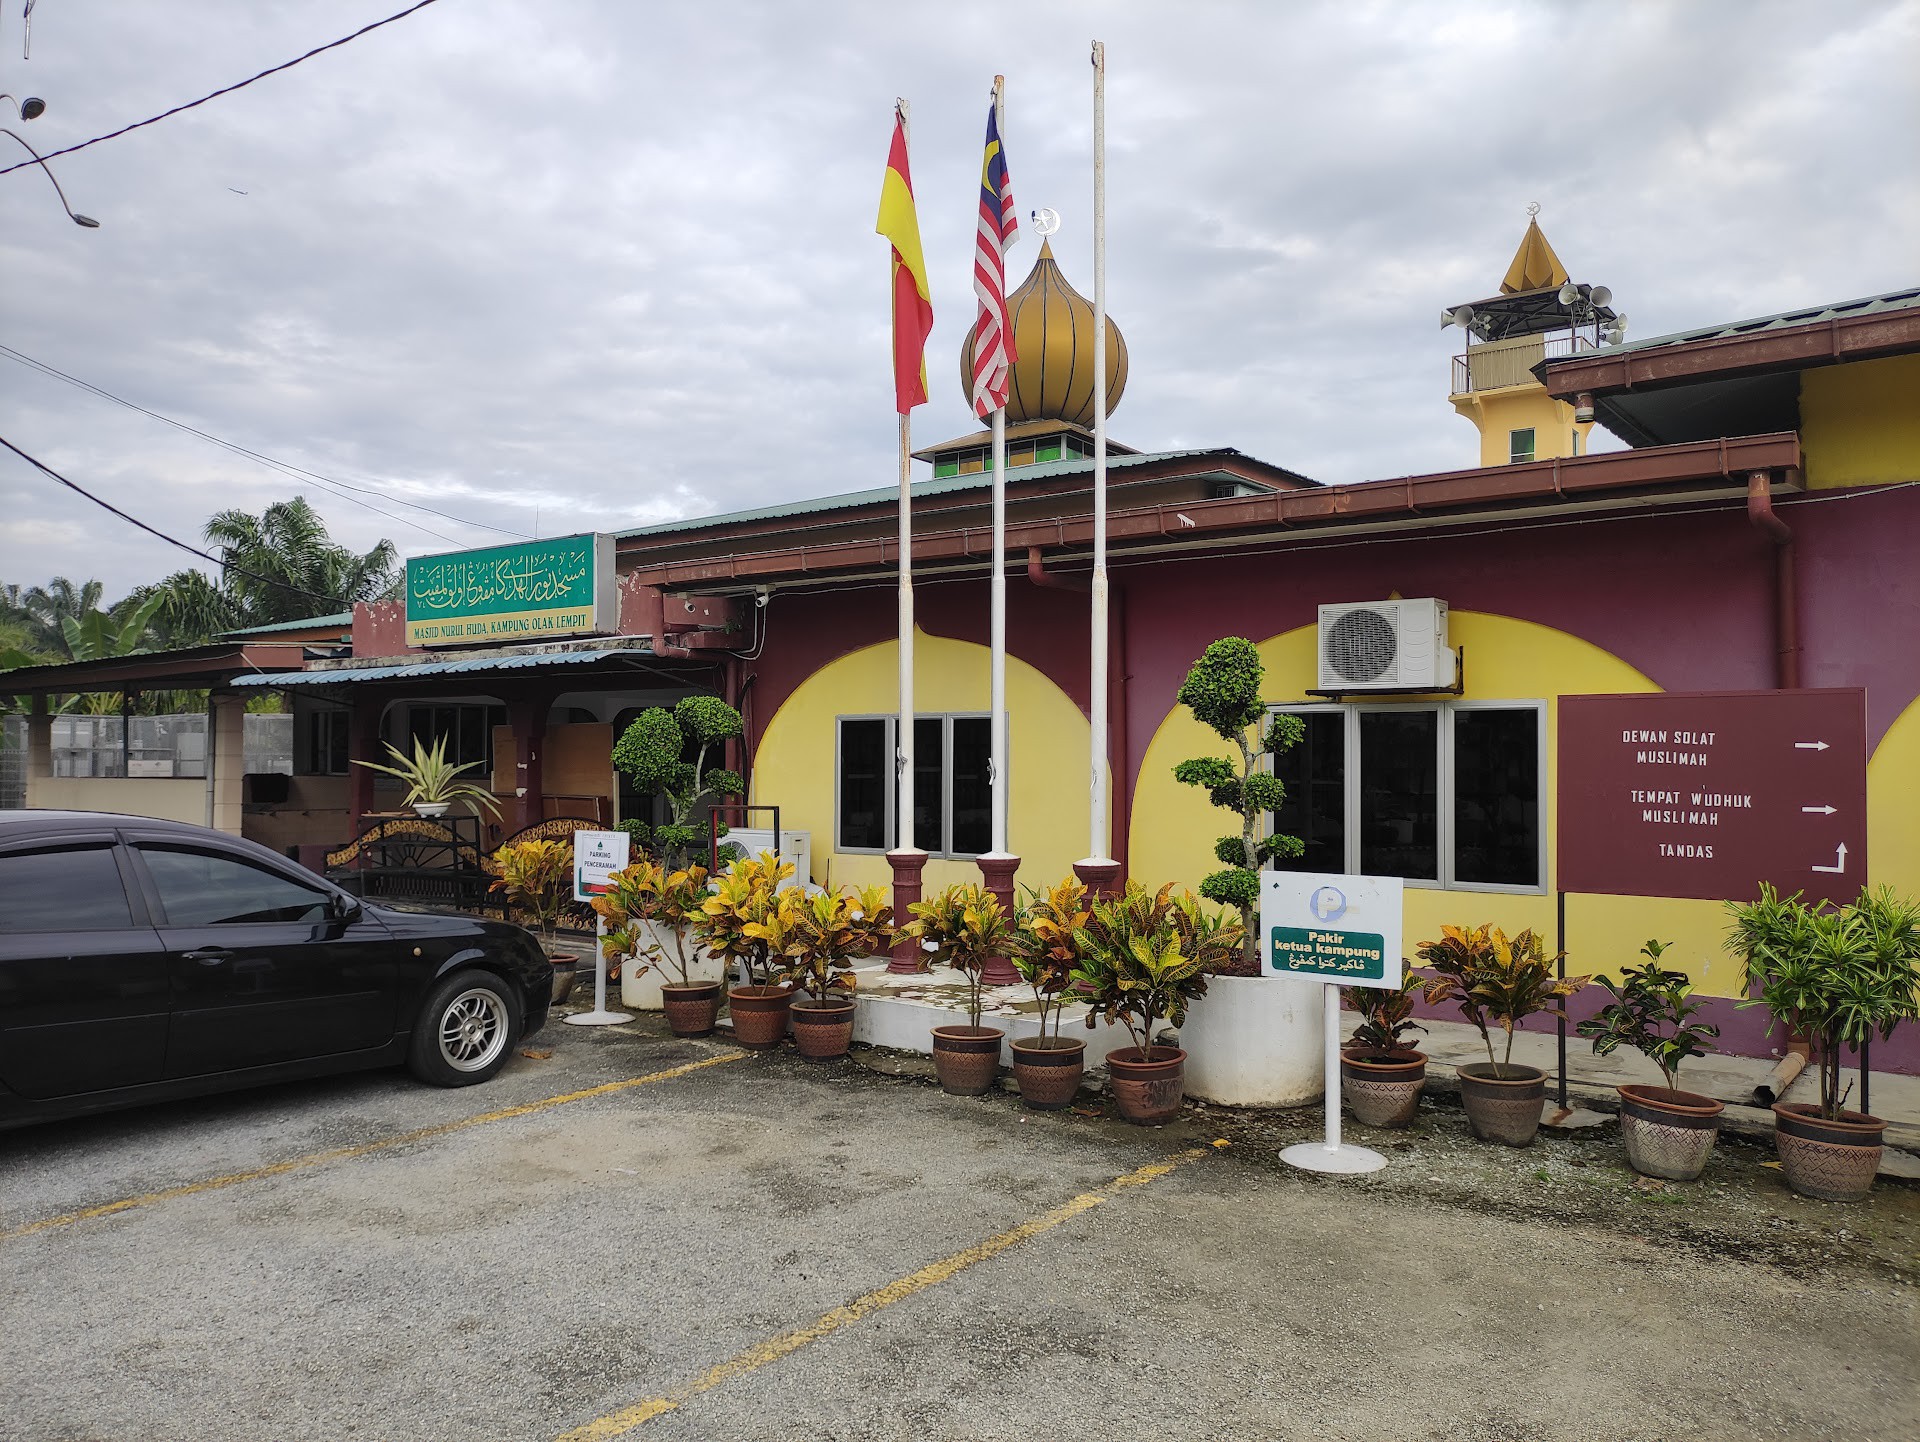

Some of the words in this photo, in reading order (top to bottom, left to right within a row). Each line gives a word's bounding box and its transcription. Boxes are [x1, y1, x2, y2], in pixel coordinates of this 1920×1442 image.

[414, 626, 439, 640] MASJID
[441, 624, 464, 638] NURUL
[467, 622, 489, 636] HUDA,
[491, 619, 530, 634] KAMPUNG
[532, 617, 554, 630] OLAK
[556, 614, 587, 629] LEMPIT
[1622, 730, 1667, 743] DEWAN
[1674, 731, 1715, 746] SOLAT
[1636, 751, 1707, 766] MUSLIMAH
[1631, 790, 1681, 804] TEMPAT
[1691, 792, 1752, 808] WUDHUK
[1642, 810, 1718, 826] MUSLIMAH
[1659, 844, 1713, 858] TANDAS
[1317, 889, 1342, 918] P
[1308, 931, 1344, 944] Pakir
[1275, 940, 1312, 953] ketua
[1316, 942, 1380, 960] kampung
